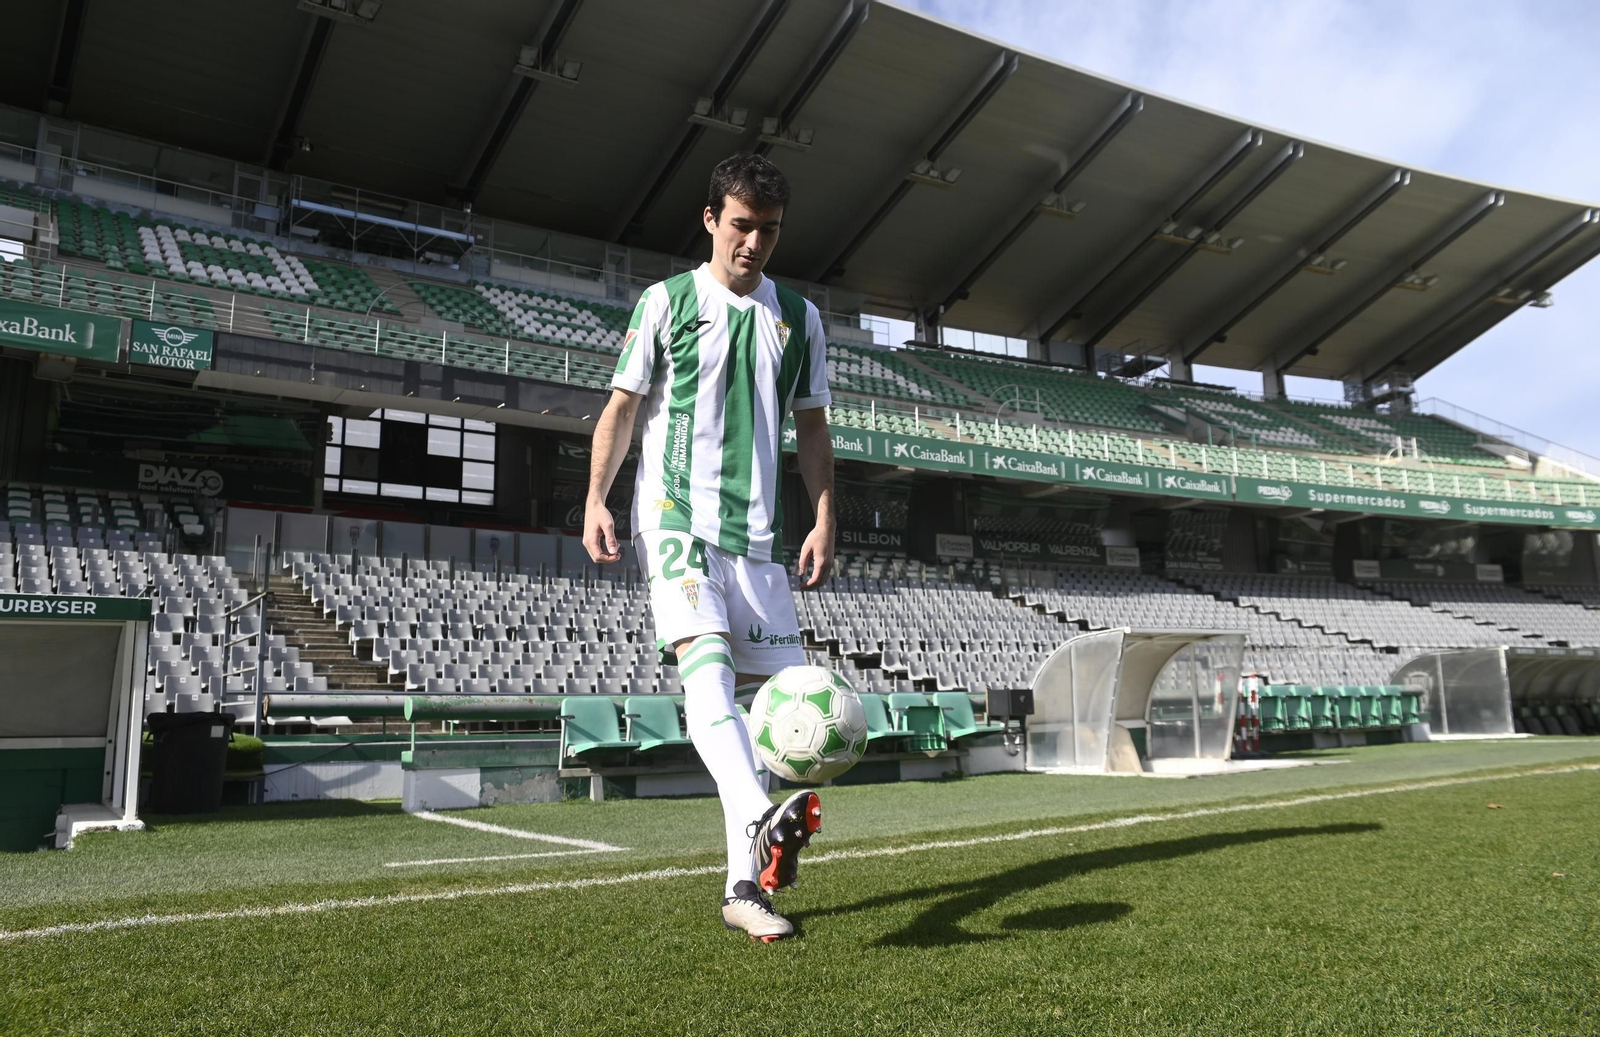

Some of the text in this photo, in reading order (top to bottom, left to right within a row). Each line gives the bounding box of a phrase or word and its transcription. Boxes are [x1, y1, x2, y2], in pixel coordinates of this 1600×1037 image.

[0, 316, 77, 344] xaBank
[166, 333, 183, 341] MINI
[132, 341, 211, 361] SAN RAFAEL
[149, 354, 195, 370] MOTOR
[670, 419, 682, 469] PATRIMONIO
[678, 413, 690, 472] HUMANIDAD
[830, 435, 864, 452] aBank
[910, 445, 966, 465] CaixaBank
[1007, 460, 1059, 476] CaixaBank
[1096, 467, 1144, 486] CaixaBank
[137, 482, 158, 491] food
[1177, 478, 1221, 493] CaixaBank
[1309, 489, 1406, 509] Supermercados
[1463, 503, 1555, 520] Supermercados
[842, 531, 901, 546] SILBON
[659, 537, 710, 581] 24
[0, 598, 97, 615] URBYSER
